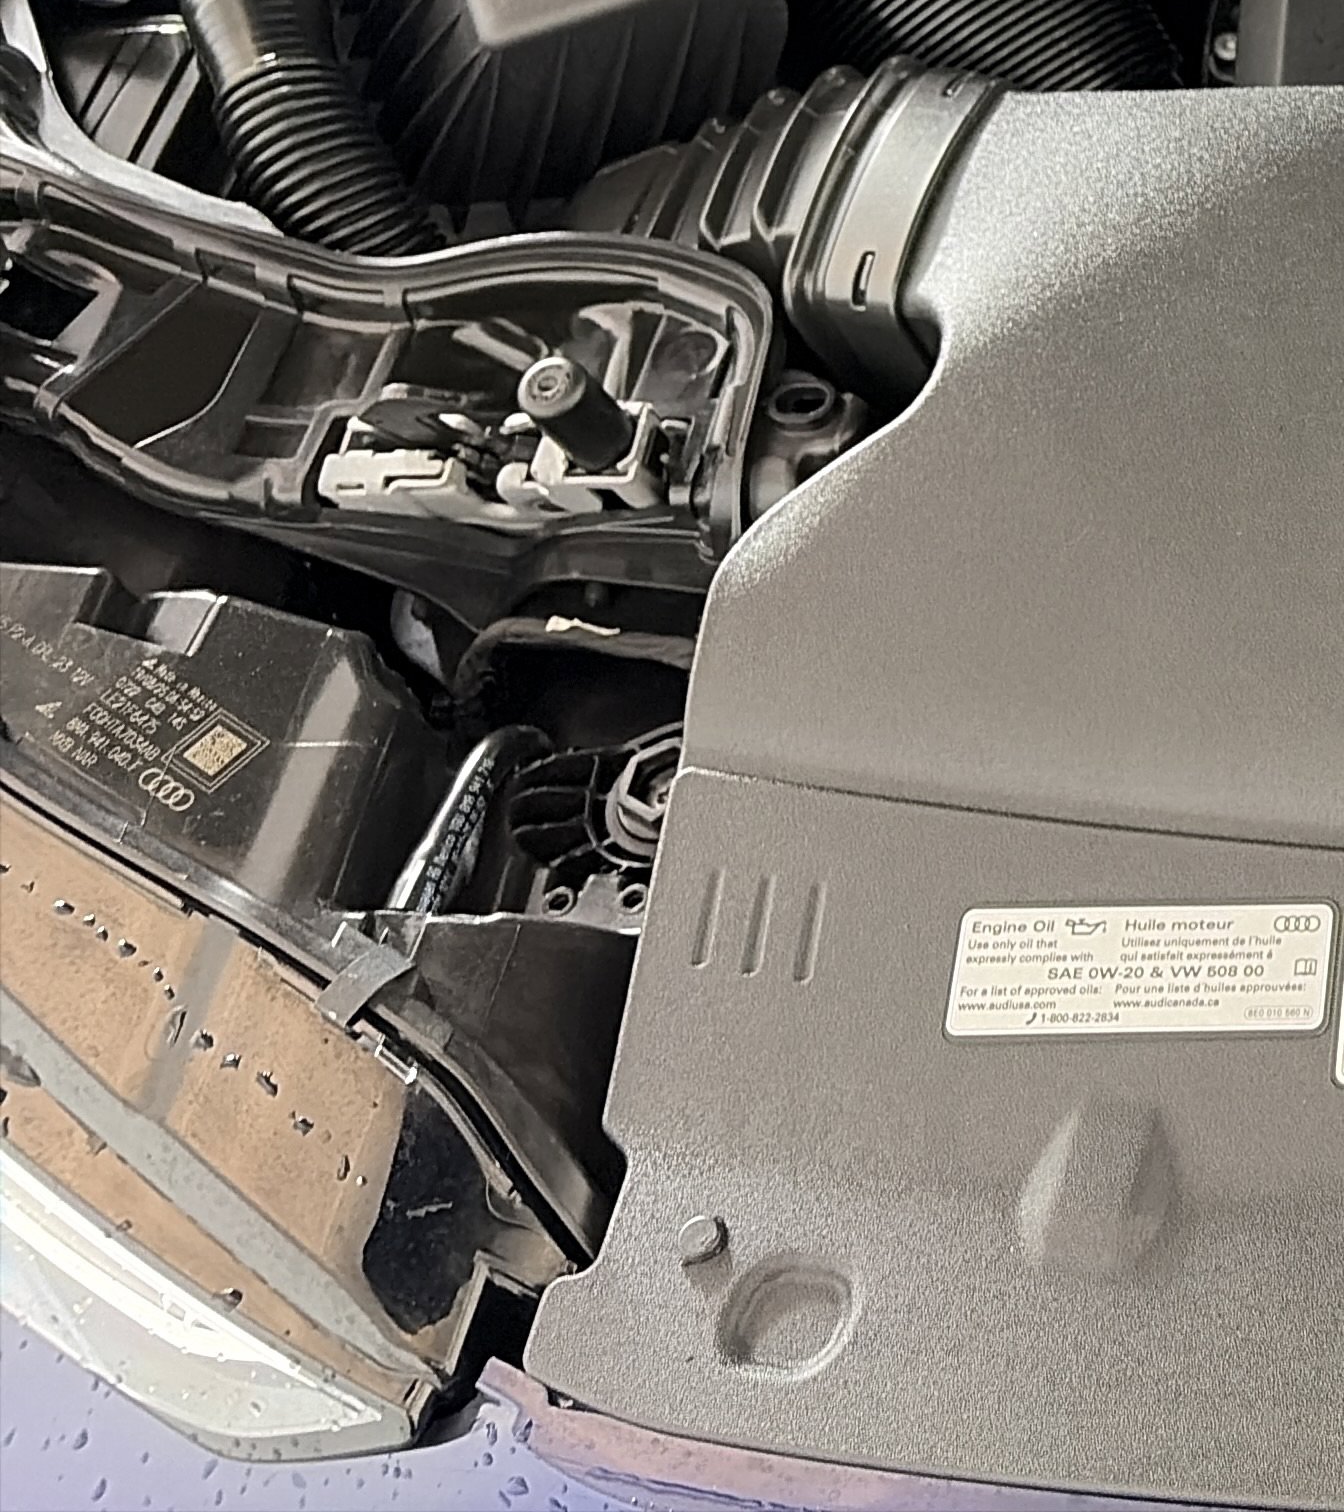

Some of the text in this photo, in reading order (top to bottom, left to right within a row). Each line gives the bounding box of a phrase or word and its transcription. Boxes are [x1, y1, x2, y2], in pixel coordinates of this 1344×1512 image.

[972, 920, 1055, 935] Engine Oil
[1125, 919, 1234, 932] Huile moteur
[968, 939, 1057, 951] Use only oil that
[1121, 937, 1161, 948] Utilisez
[1164, 936, 1229, 948] uniquement
[1232, 936, 1245, 946] de
[966, 952, 1094, 965] expressly complies with
[1120, 951, 1138, 963] qui
[1141, 950, 1183, 961] satisfait
[1047, 965, 1264, 980] SAE 0W-20 & VW 508 00
[960, 984, 1102, 998] For a list of approved oils:
[1115, 983, 1140, 995] Pour
[1143, 985, 1164, 994] une
[1167, 983, 1190, 994] liste
[958, 1001, 1057, 1011] www.audiusa.com
[1113, 997, 1220, 1009] www.audicanada.ca
[1041, 1012, 1120, 1024] 1-800-822-2834
